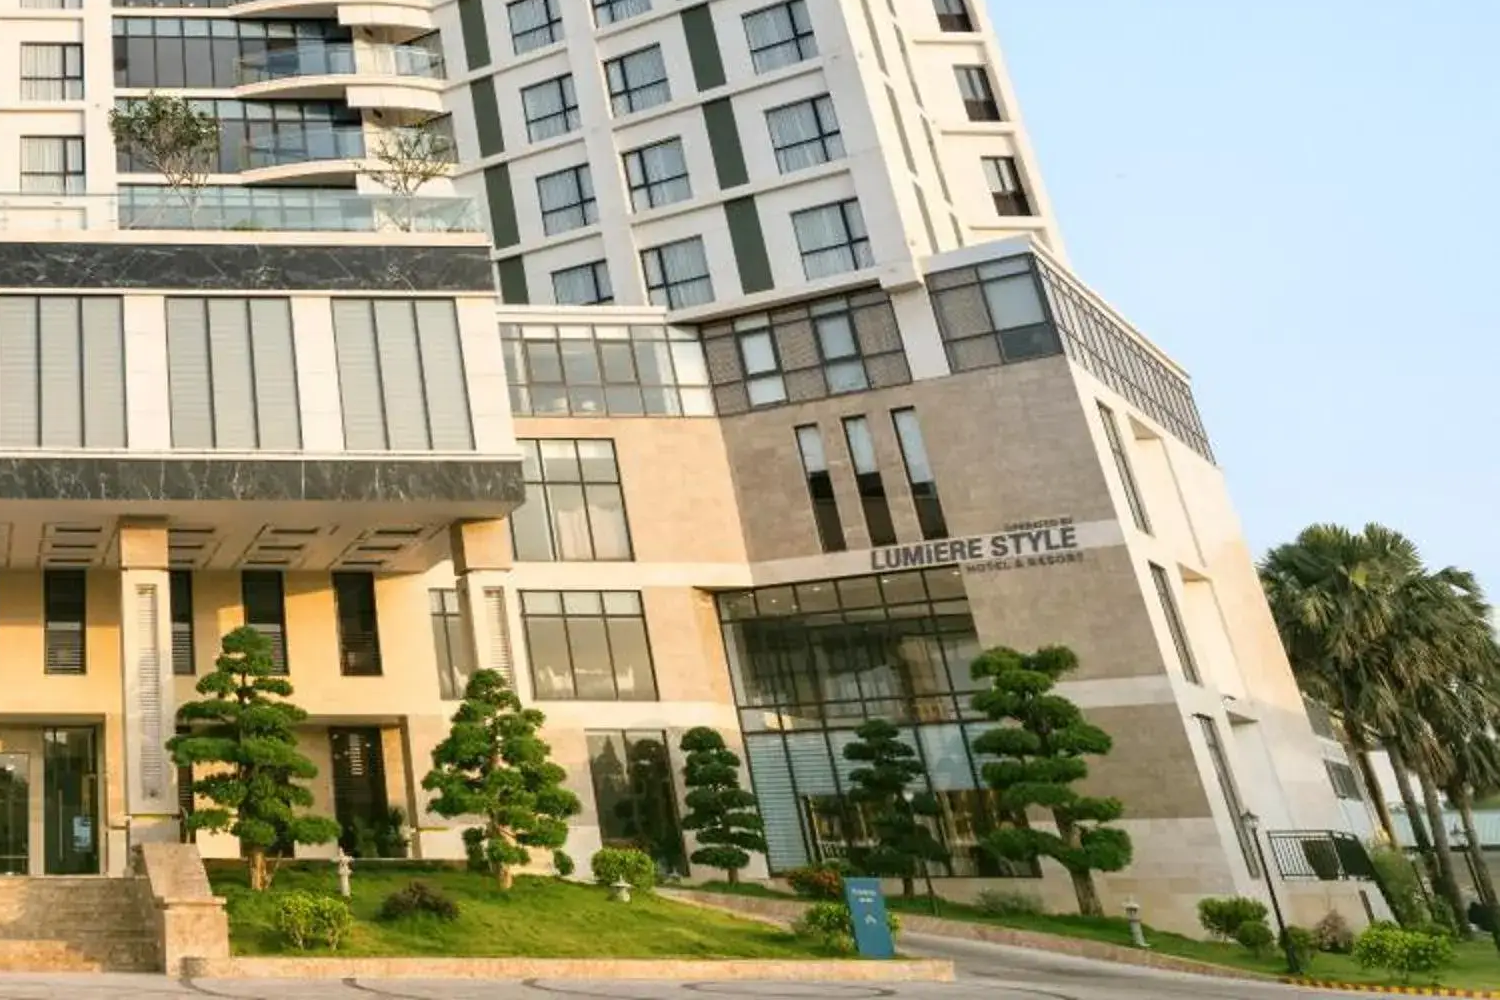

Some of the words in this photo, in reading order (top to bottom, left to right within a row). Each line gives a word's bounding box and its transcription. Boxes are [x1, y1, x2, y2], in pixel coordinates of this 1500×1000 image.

[991, 526, 1078, 557] STYLE
[966, 560, 1011, 573] HOTEL
[1027, 551, 1083, 567] RESORT
